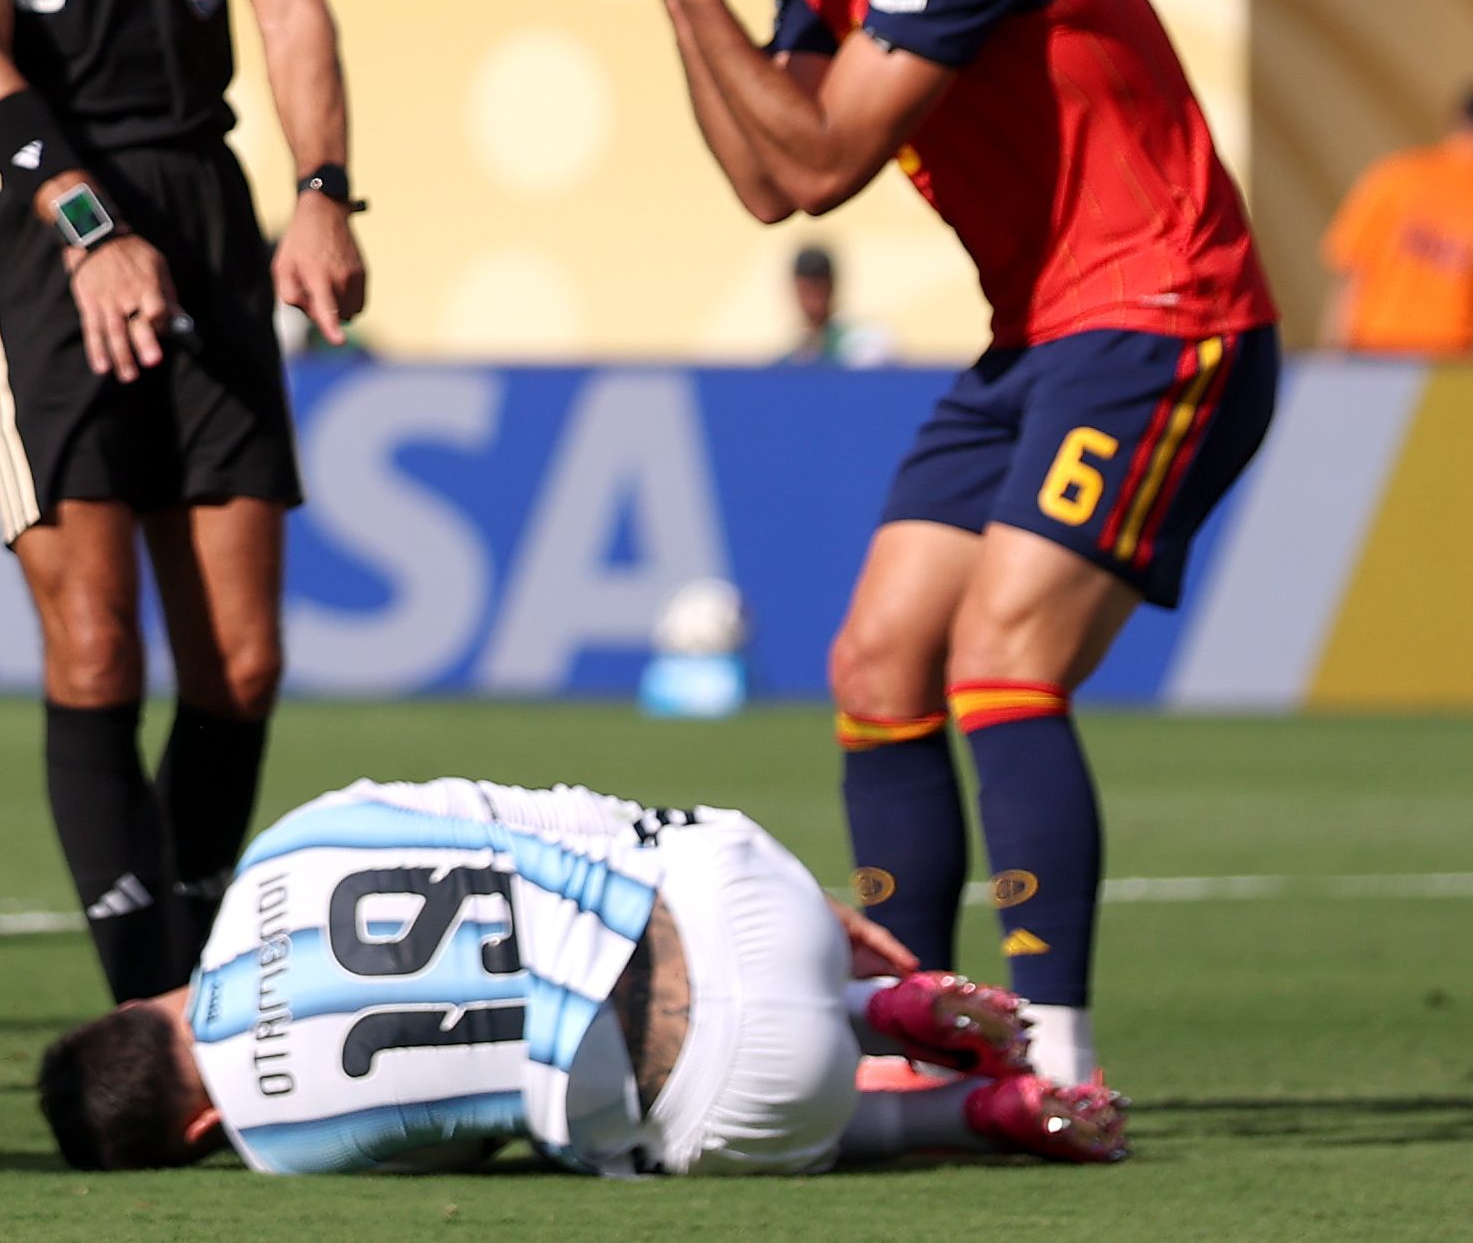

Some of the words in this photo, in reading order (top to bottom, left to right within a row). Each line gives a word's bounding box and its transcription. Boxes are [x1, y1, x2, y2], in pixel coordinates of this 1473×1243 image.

[1037, 427, 1119, 527] 6
[254, 871, 295, 1096] OTAMENDI
[330, 866, 525, 1078] 19
